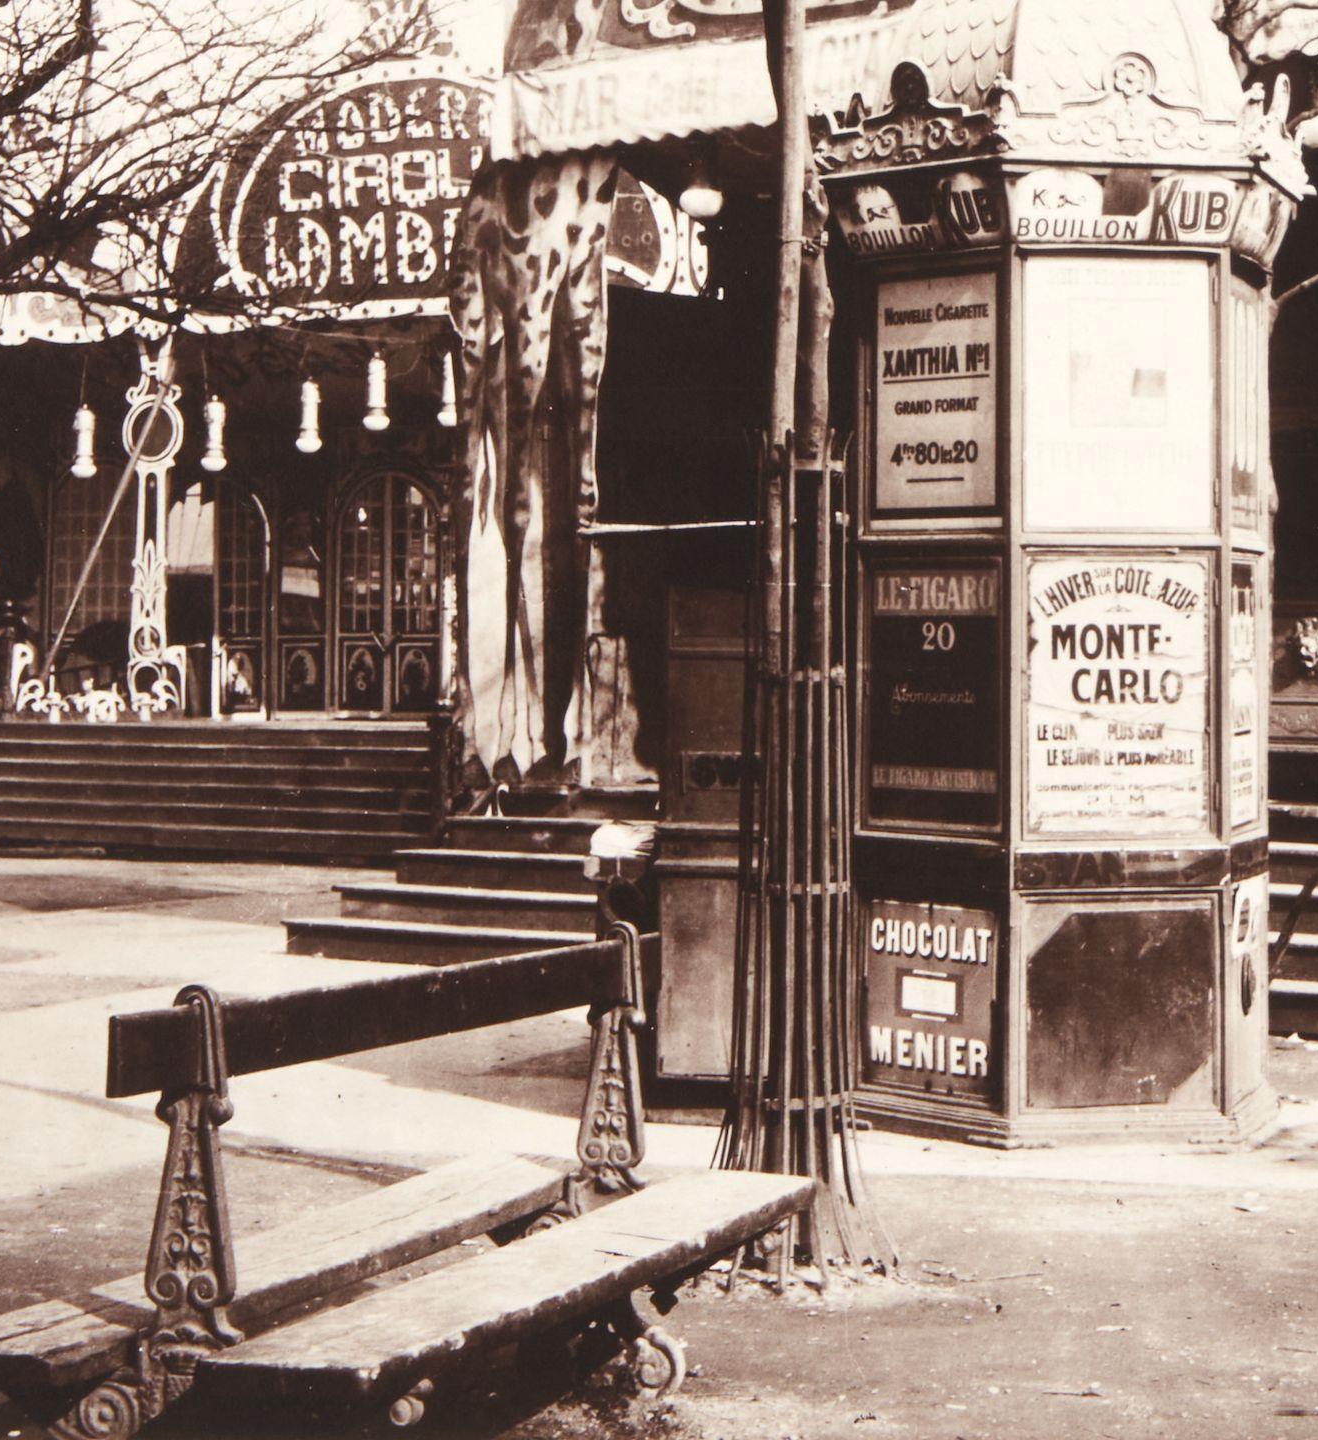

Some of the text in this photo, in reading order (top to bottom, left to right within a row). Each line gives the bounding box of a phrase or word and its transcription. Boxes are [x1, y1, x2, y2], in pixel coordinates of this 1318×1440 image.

[847, 178, 1001, 254] BOUILLON KUB
[1016, 178, 1231, 242] BOUILLON KUB
[883, 345, 959, 378] XANTHIA
[894, 396, 979, 416] GRAND FORMAT
[877, 575, 996, 611] LE FIGARO
[922, 621, 955, 651] 20
[1071, 667, 1184, 705] CARLO
[1037, 723, 1049, 741] LE
[1047, 748, 1058, 767] LE
[871, 917, 992, 962] CHOCOLAT
[870, 1025, 988, 1078] MENIER
